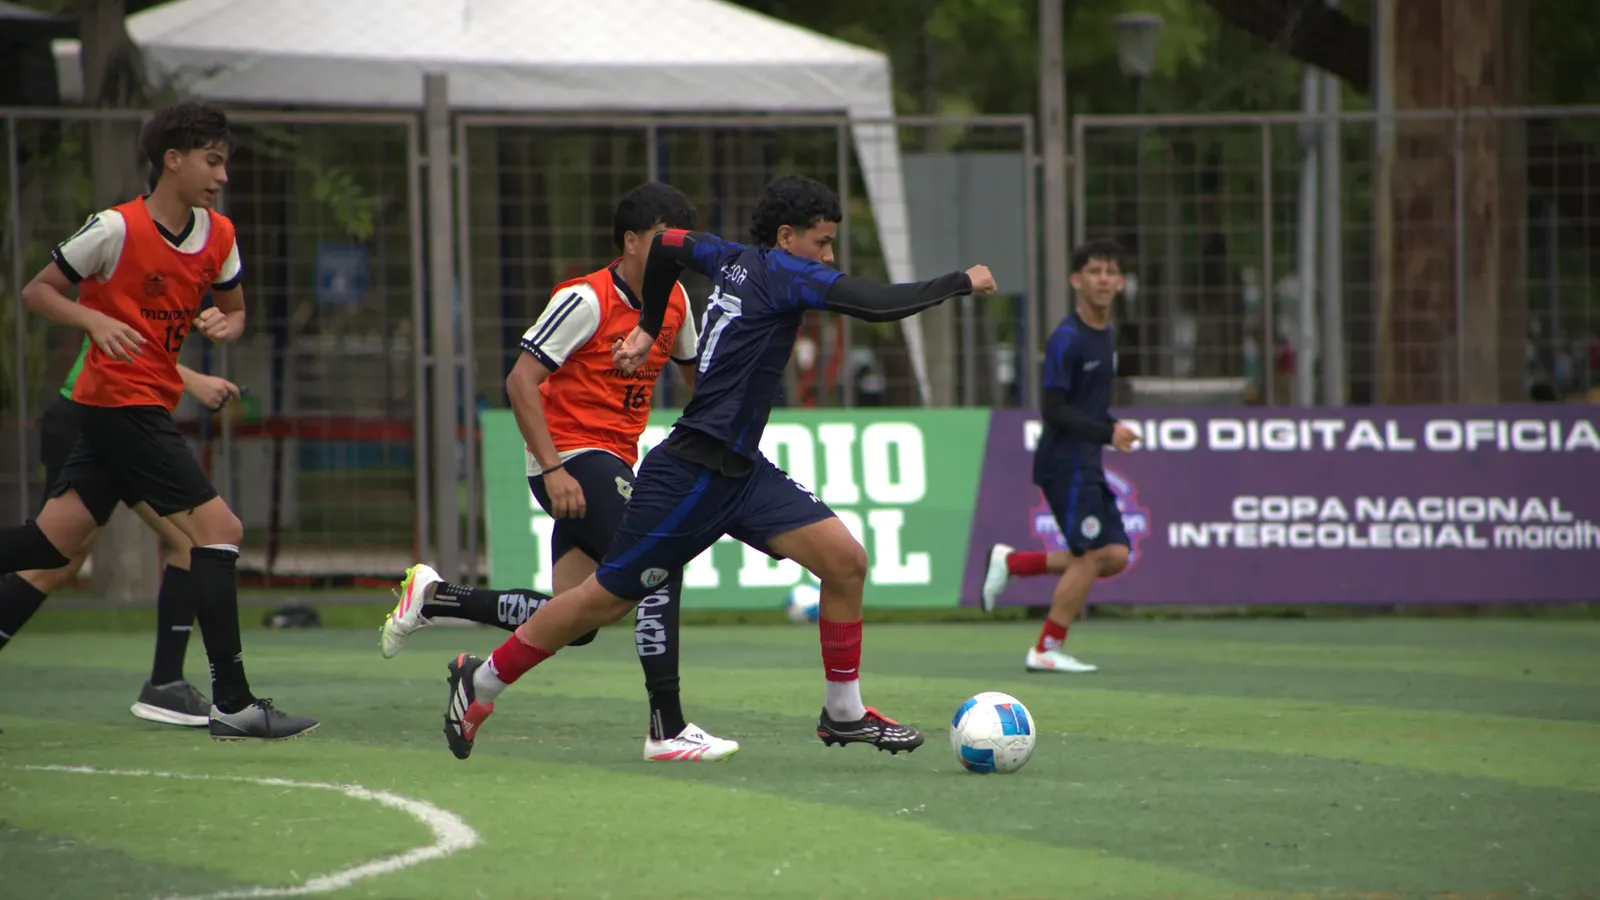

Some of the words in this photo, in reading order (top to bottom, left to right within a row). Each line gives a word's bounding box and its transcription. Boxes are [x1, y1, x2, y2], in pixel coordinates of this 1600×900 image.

[623, 385, 647, 409] 16
[1207, 419, 1416, 451] DIGITAL
[1424, 419, 1600, 451] OFICIA
[1232, 496, 1349, 521] COPA
[1355, 496, 1574, 521] NACIONAL
[1168, 523, 1489, 548] INTERCOLEGIAL
